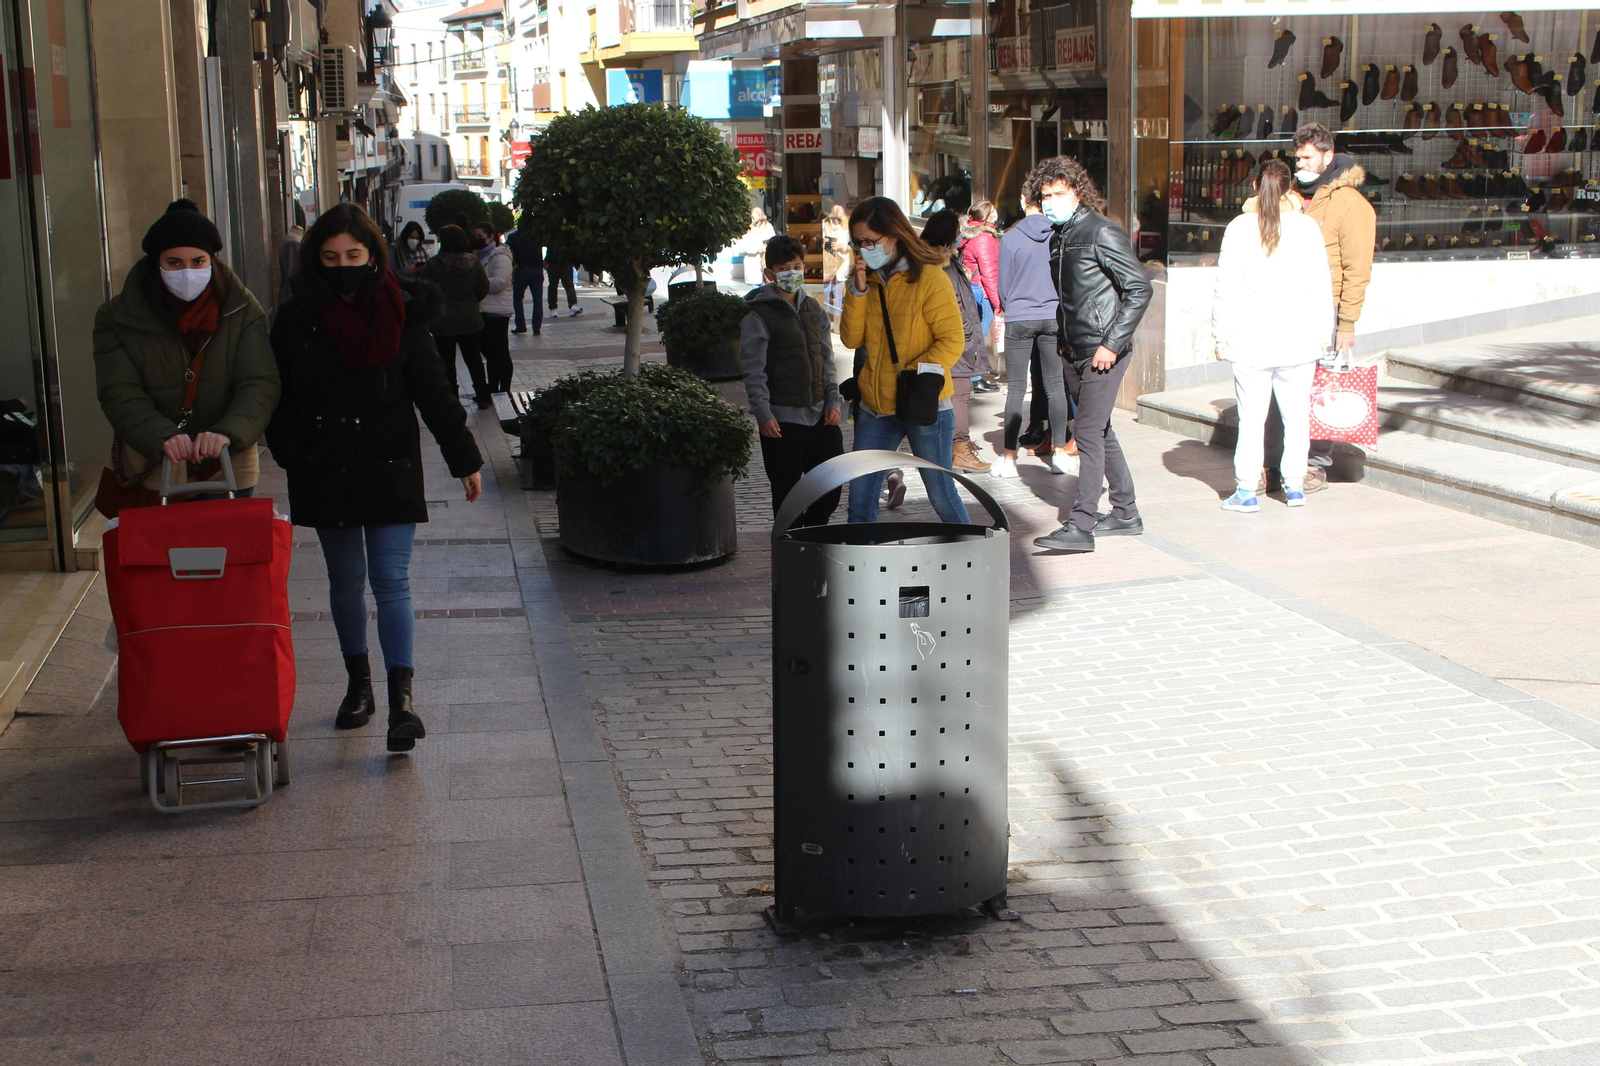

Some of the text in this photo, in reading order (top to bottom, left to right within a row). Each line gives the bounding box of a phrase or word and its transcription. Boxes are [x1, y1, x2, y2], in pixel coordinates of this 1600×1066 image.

[998, 43, 1029, 69] REBAAS
[1057, 34, 1095, 65] REBAJAS
[626, 82, 645, 104] a
[786, 133, 822, 149] REBA
